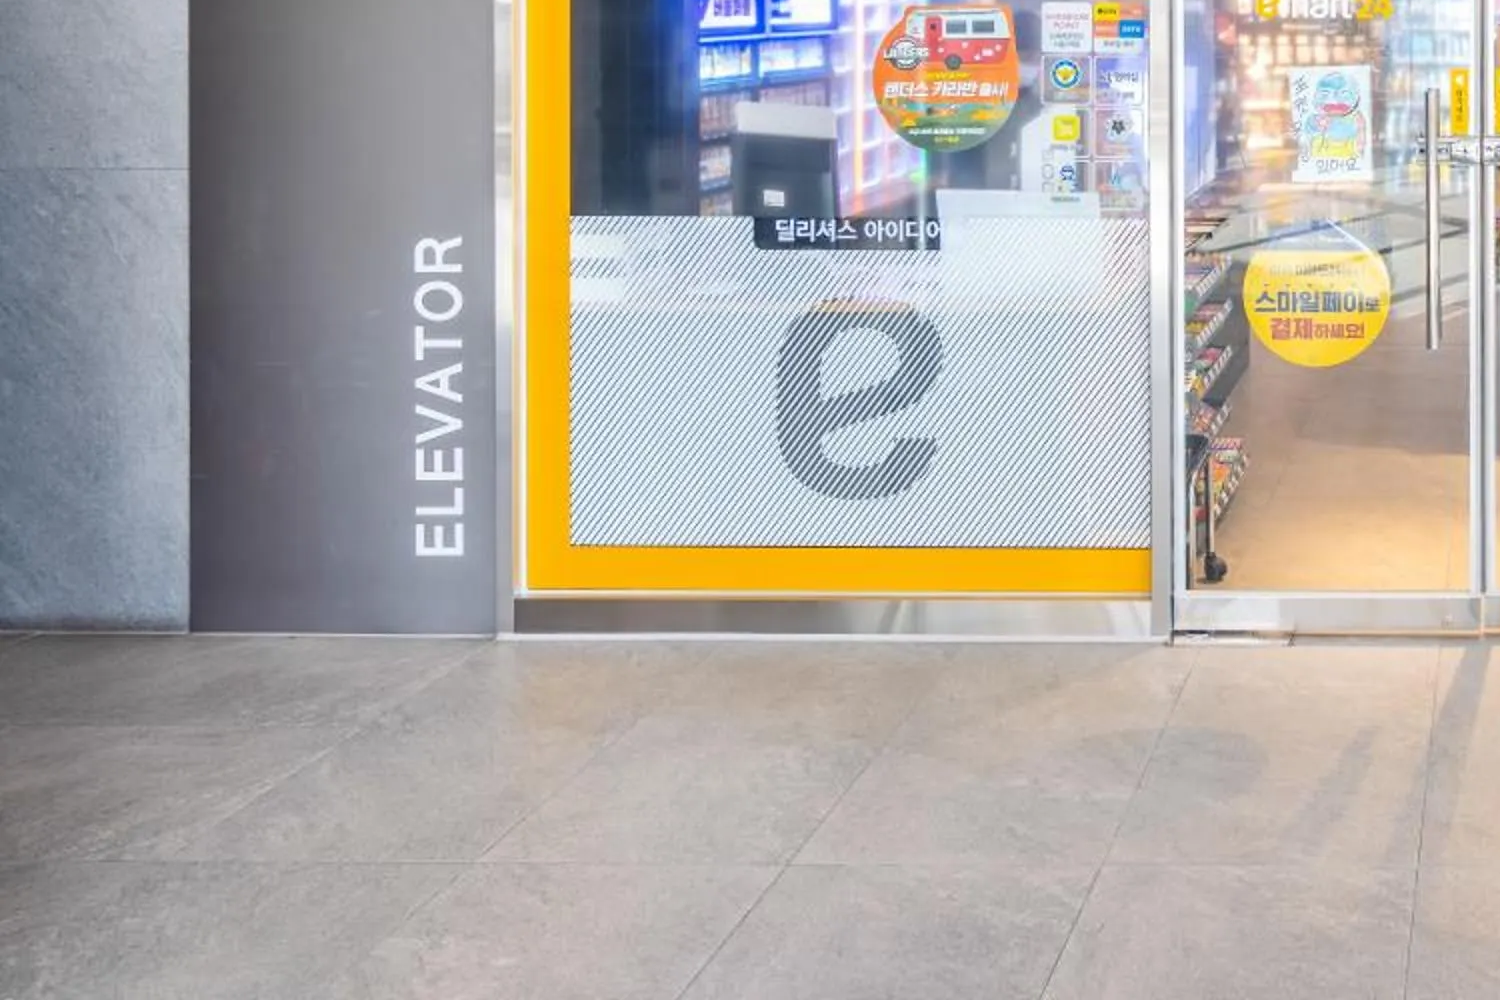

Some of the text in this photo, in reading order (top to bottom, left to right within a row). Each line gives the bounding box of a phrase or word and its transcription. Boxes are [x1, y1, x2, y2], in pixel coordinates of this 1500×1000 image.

[775, 219, 857, 242] 딜리셔스
[1254, 289, 1380, 312] 스마일페이로
[414, 235, 464, 557] ELEVATOR
[776, 297, 944, 500] e
